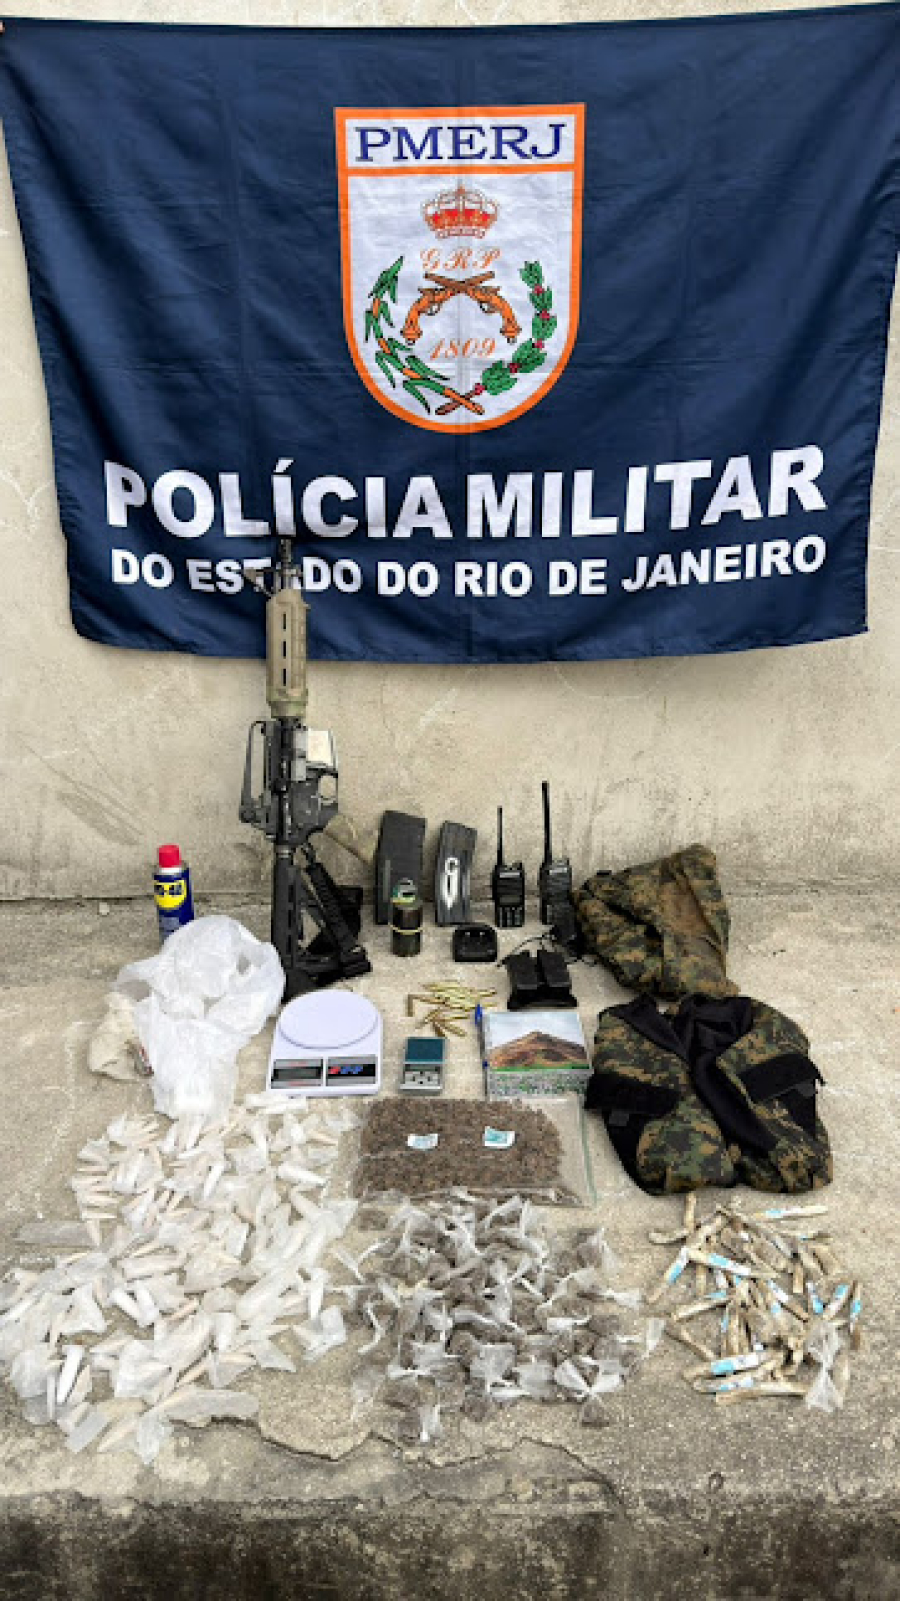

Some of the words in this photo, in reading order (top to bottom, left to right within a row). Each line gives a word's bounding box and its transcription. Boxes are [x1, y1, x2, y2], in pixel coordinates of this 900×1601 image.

[355, 123, 567, 162] PMERJ
[429, 337, 496, 361] 1809
[103, 458, 453, 539] POLÍCIA
[466, 444, 828, 538] MILITAR
[111, 548, 174, 588] DO
[377, 561, 440, 596] DO
[454, 560, 533, 597] RIO
[549, 558, 608, 596] DE
[621, 534, 827, 592] JANEIRO
